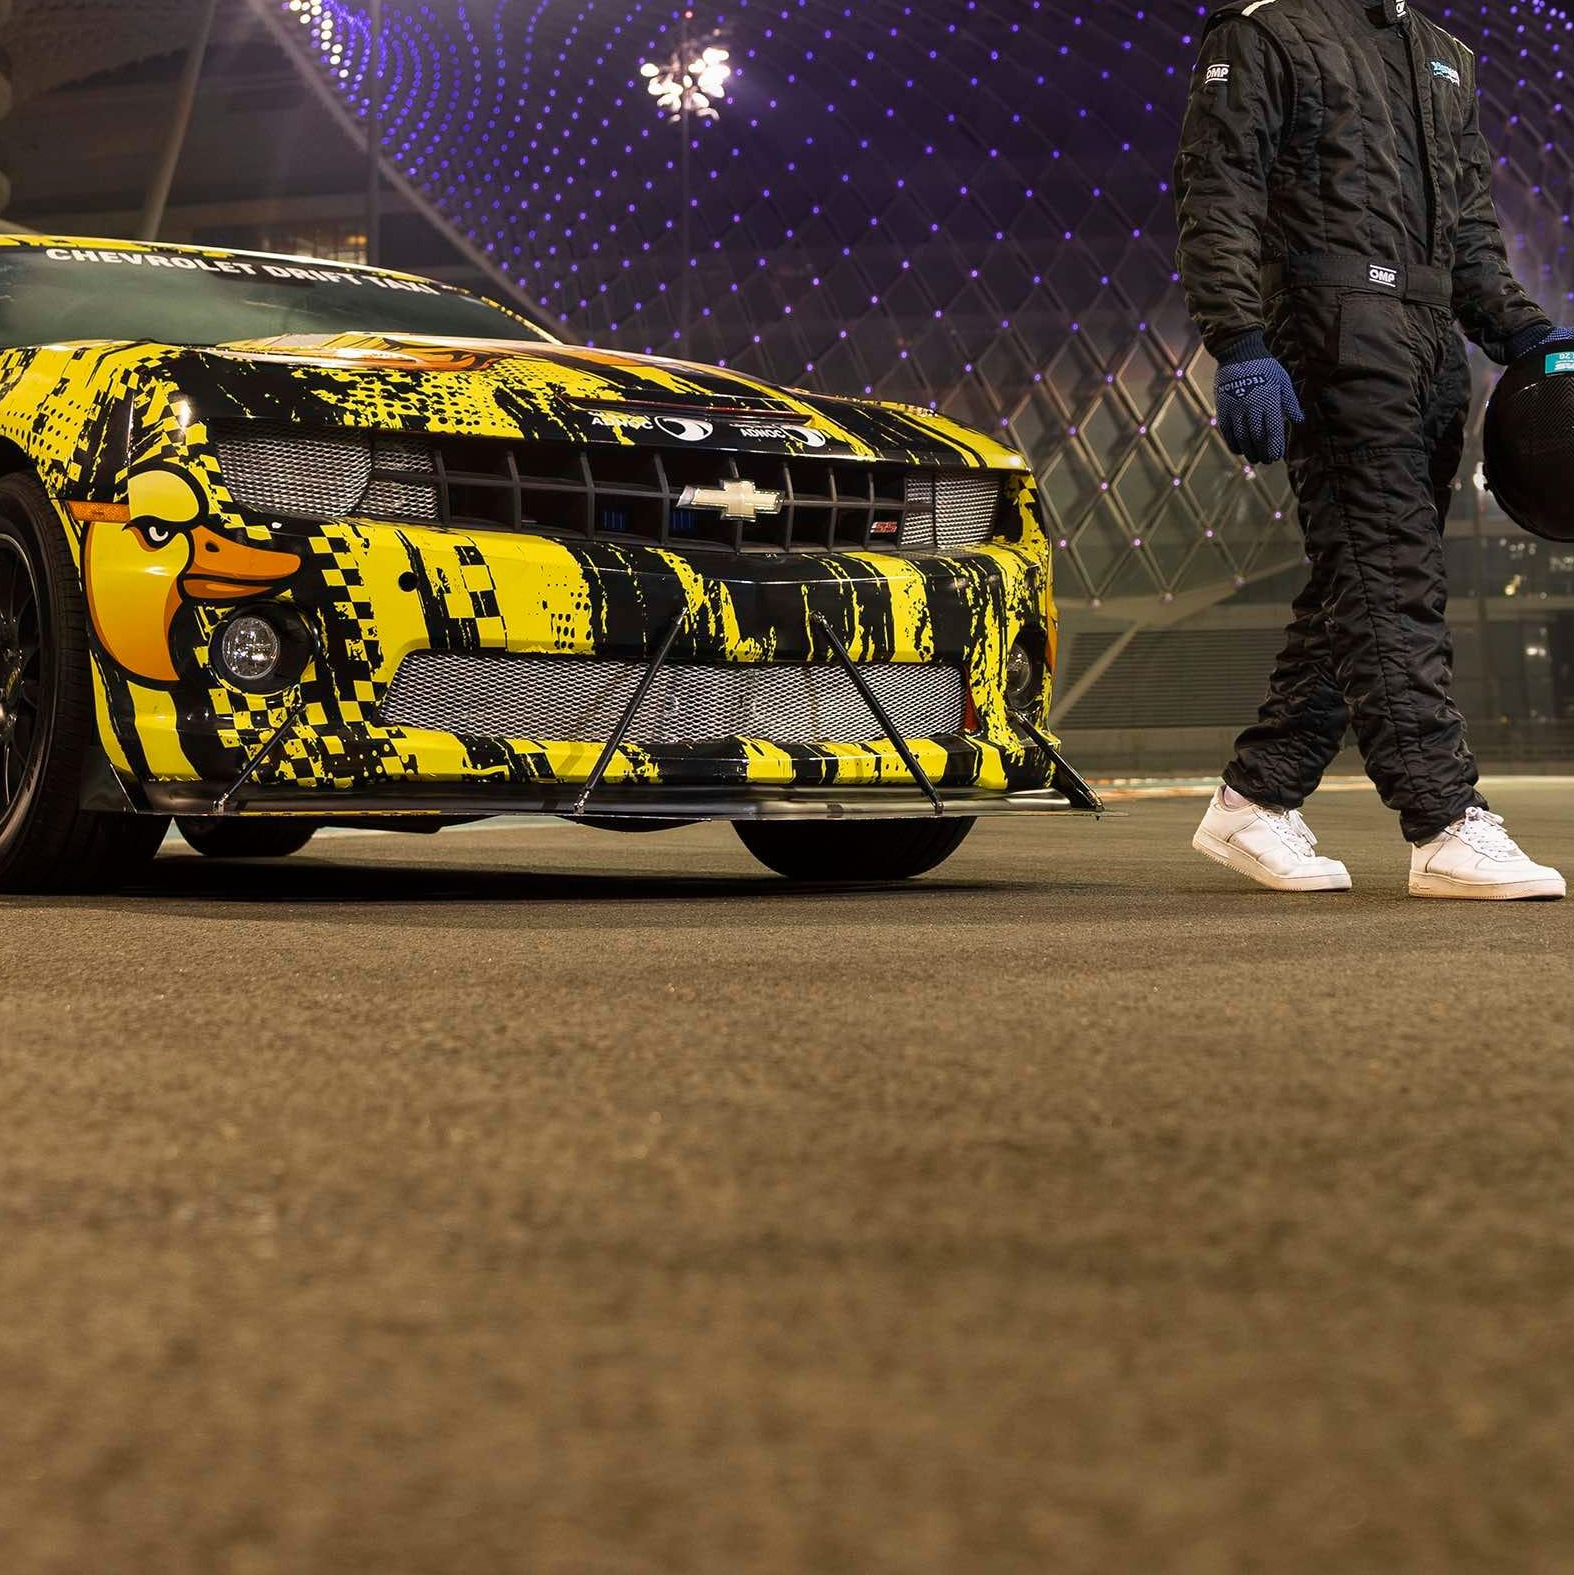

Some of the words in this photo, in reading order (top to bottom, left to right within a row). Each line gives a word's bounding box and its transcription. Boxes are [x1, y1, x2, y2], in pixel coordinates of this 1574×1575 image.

[1206, 67, 1229, 80] OMP
[45, 248, 257, 275] CHEVROLET
[261, 264, 362, 285] DRIFT
[360, 275, 441, 295] TAXI
[1369, 269, 1395, 283] OMP
[591, 417, 654, 430] ADNOC
[740, 428, 786, 439] ADNOC
